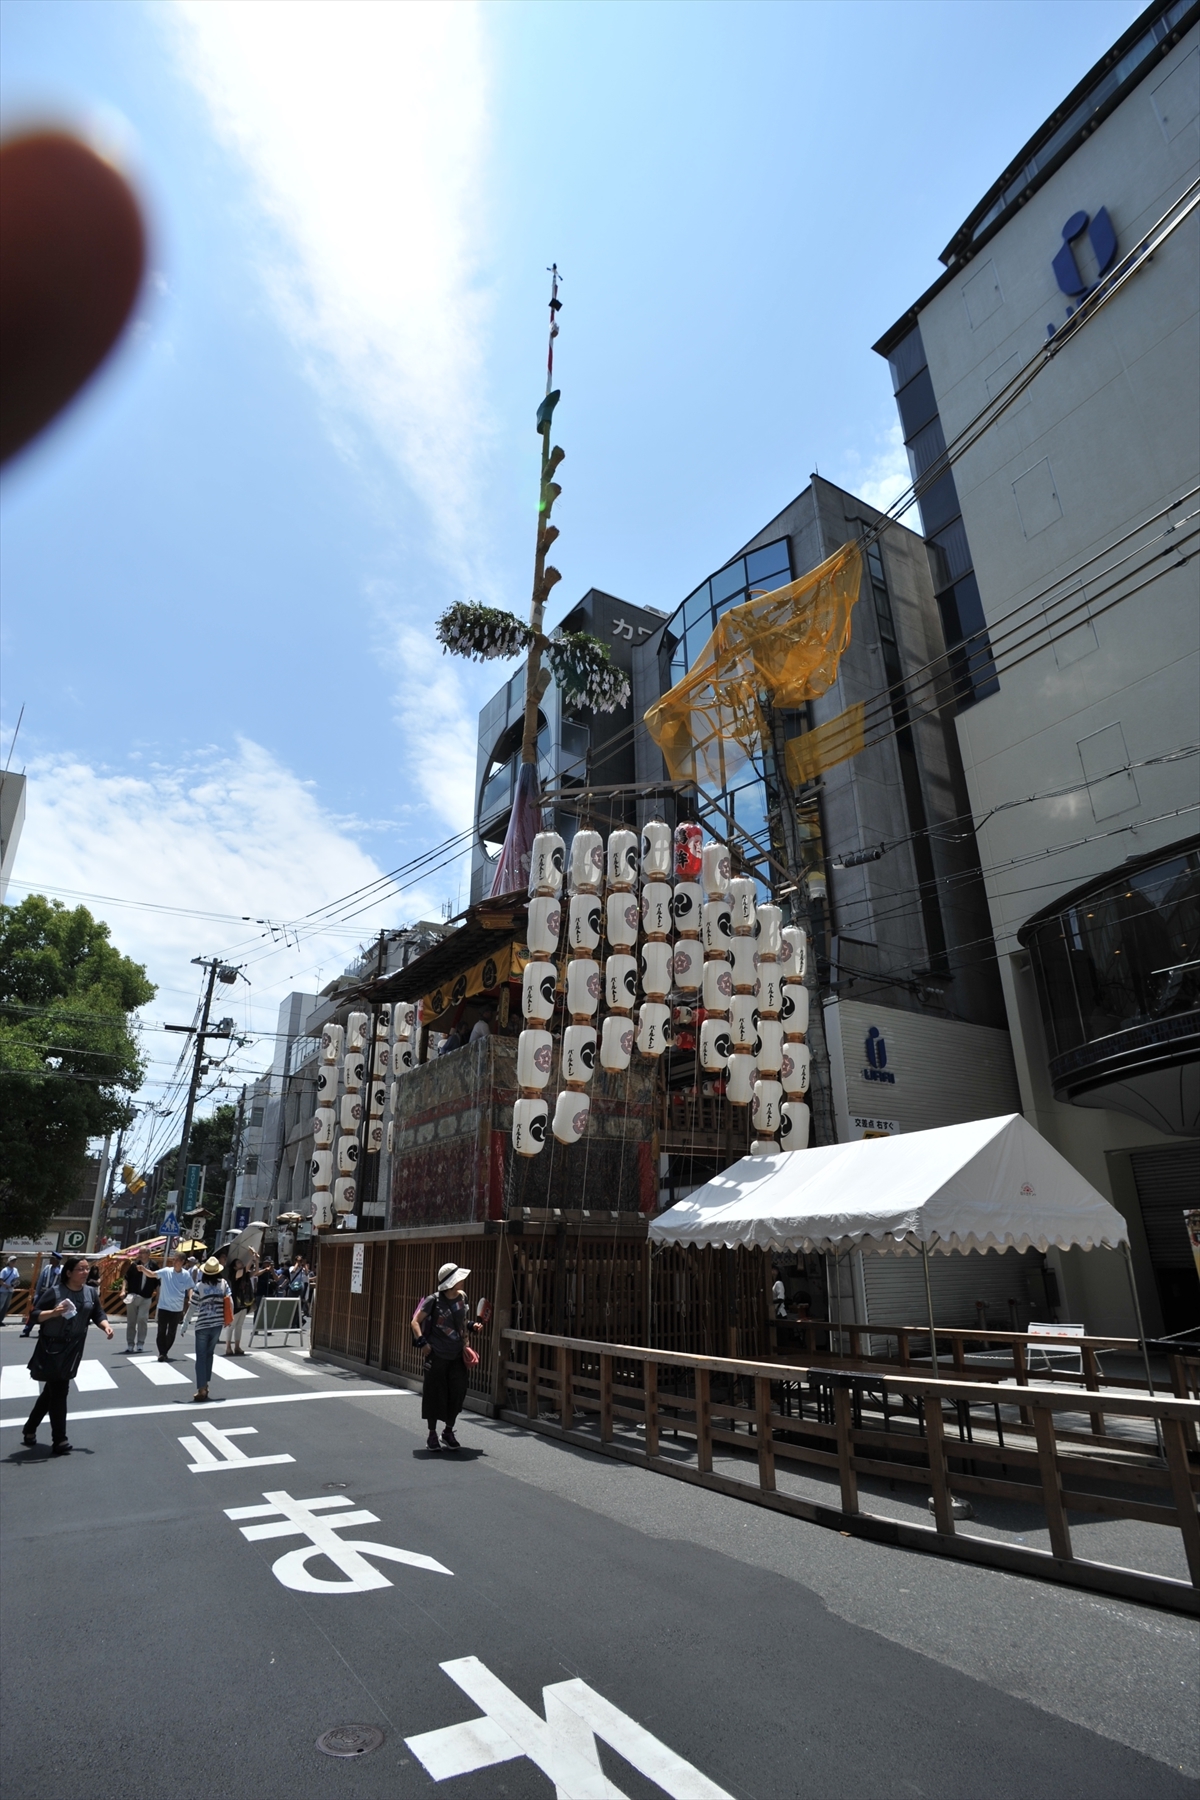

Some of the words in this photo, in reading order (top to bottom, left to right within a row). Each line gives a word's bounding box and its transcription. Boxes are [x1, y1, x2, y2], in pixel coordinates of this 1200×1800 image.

[742, 894, 750, 918] パールトーン
[610, 977, 618, 1004] パールトーン
[648, 1025, 656, 1050] パールトーン
[765, 1102, 773, 1128] パールトーン
[855, 1118, 875, 1128] 交差点
[876, 1120, 894, 1130] 右すぐ
[72, 1233, 83, 1245] P
